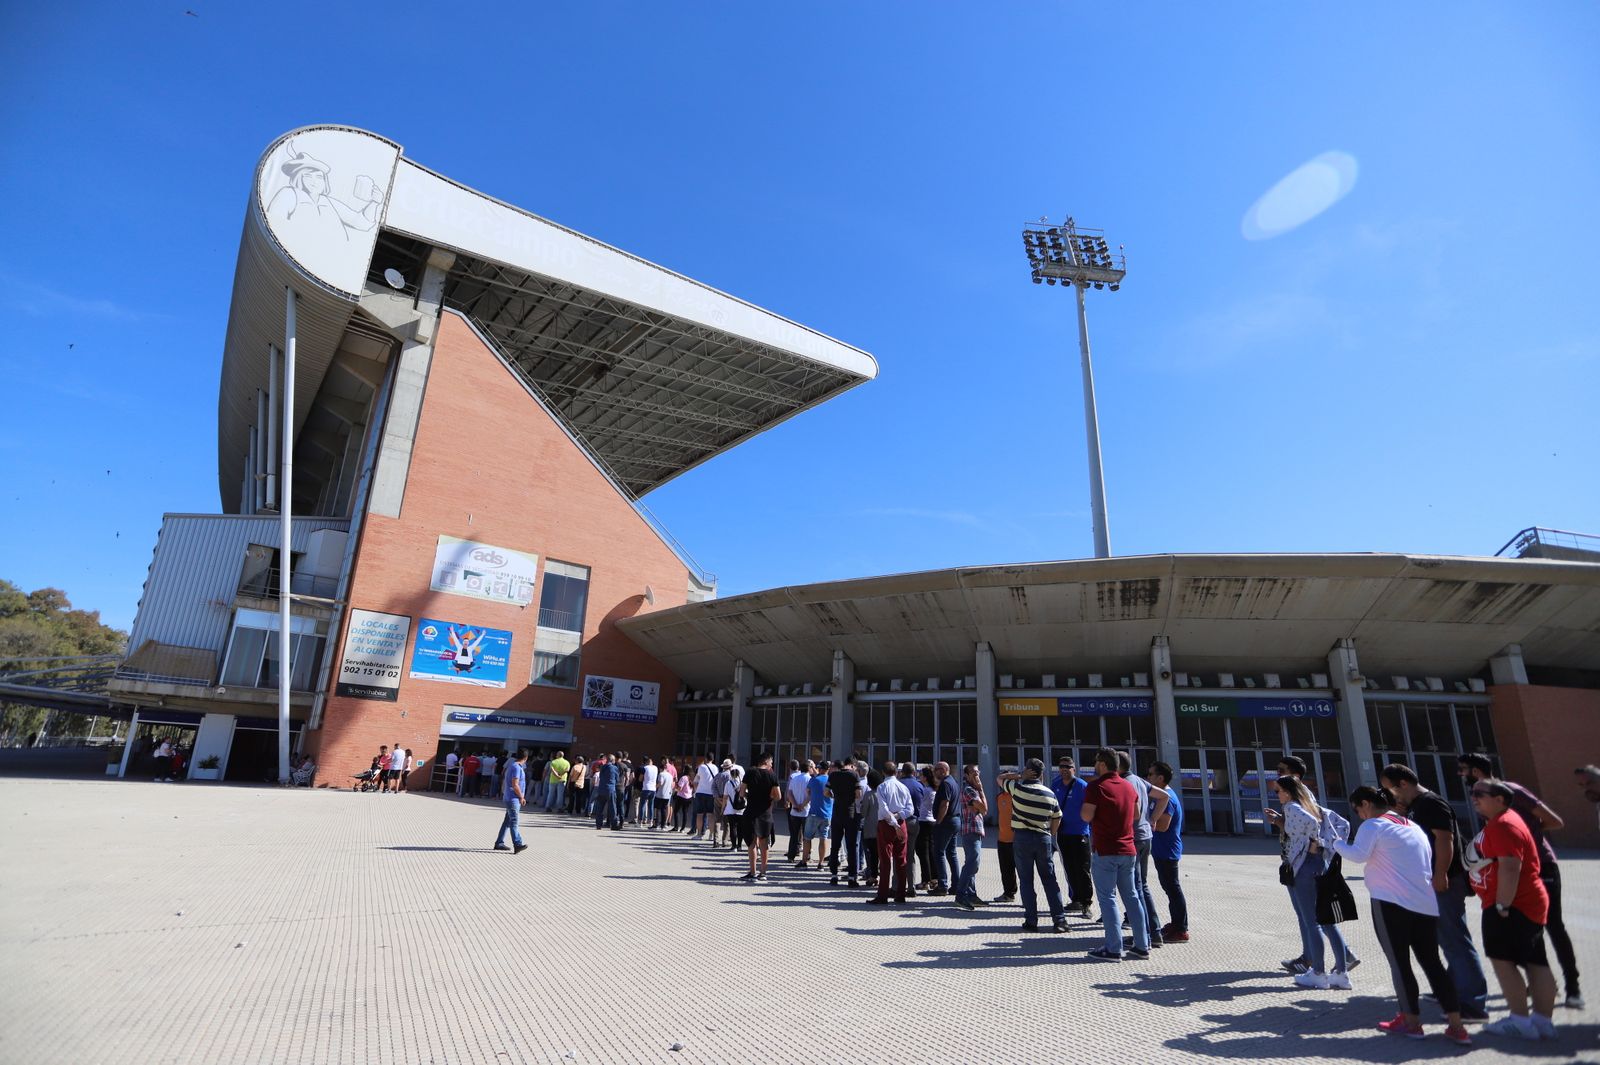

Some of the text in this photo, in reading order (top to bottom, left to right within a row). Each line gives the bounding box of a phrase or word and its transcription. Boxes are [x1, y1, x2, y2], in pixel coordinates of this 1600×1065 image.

[474, 551, 504, 565] ads
[360, 620, 400, 630] LOCALES
[350, 628, 406, 640] DISPONIBLES
[367, 638, 393, 648] VENTA
[354, 646, 396, 656] ALQUILER
[345, 658, 400, 670] Servihabitat.com
[344, 666, 360, 674] 902
[1180, 704, 1198, 712] Gol
[1201, 704, 1219, 712] Sur
